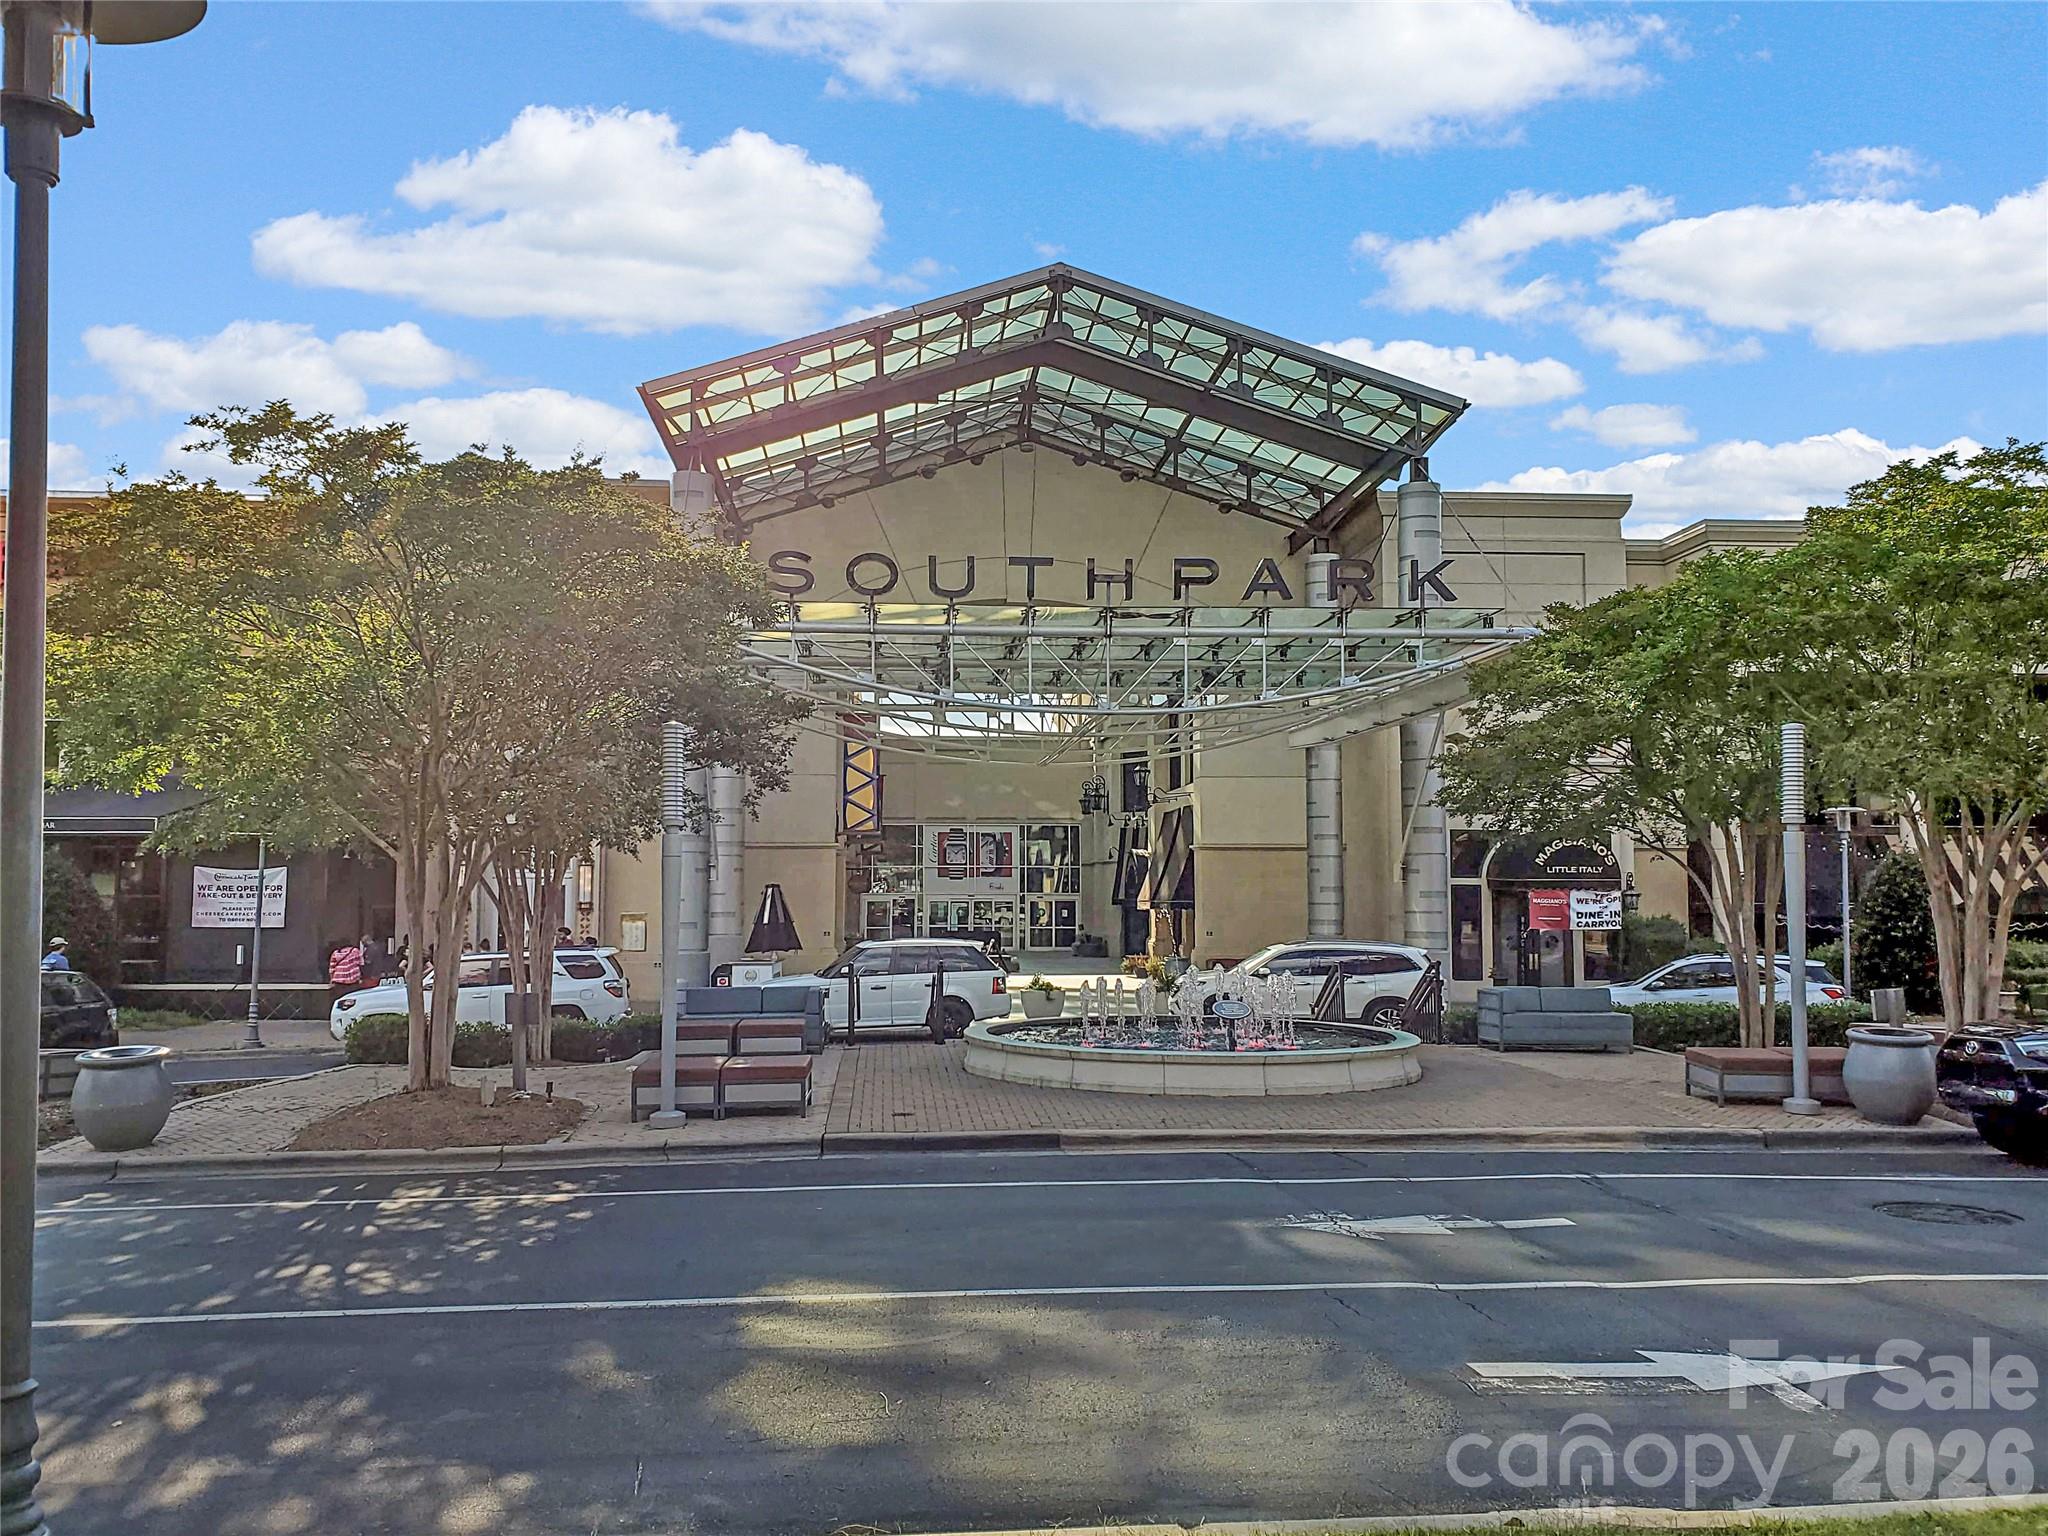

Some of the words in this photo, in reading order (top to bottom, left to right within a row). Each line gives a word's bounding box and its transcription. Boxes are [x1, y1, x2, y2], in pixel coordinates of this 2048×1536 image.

[767, 550, 1458, 602] SOUTHPARK
[43, 821, 56, 829] AR
[1576, 897, 1604, 905] WE'RE
[1576, 911, 1621, 920] DINE-IN
